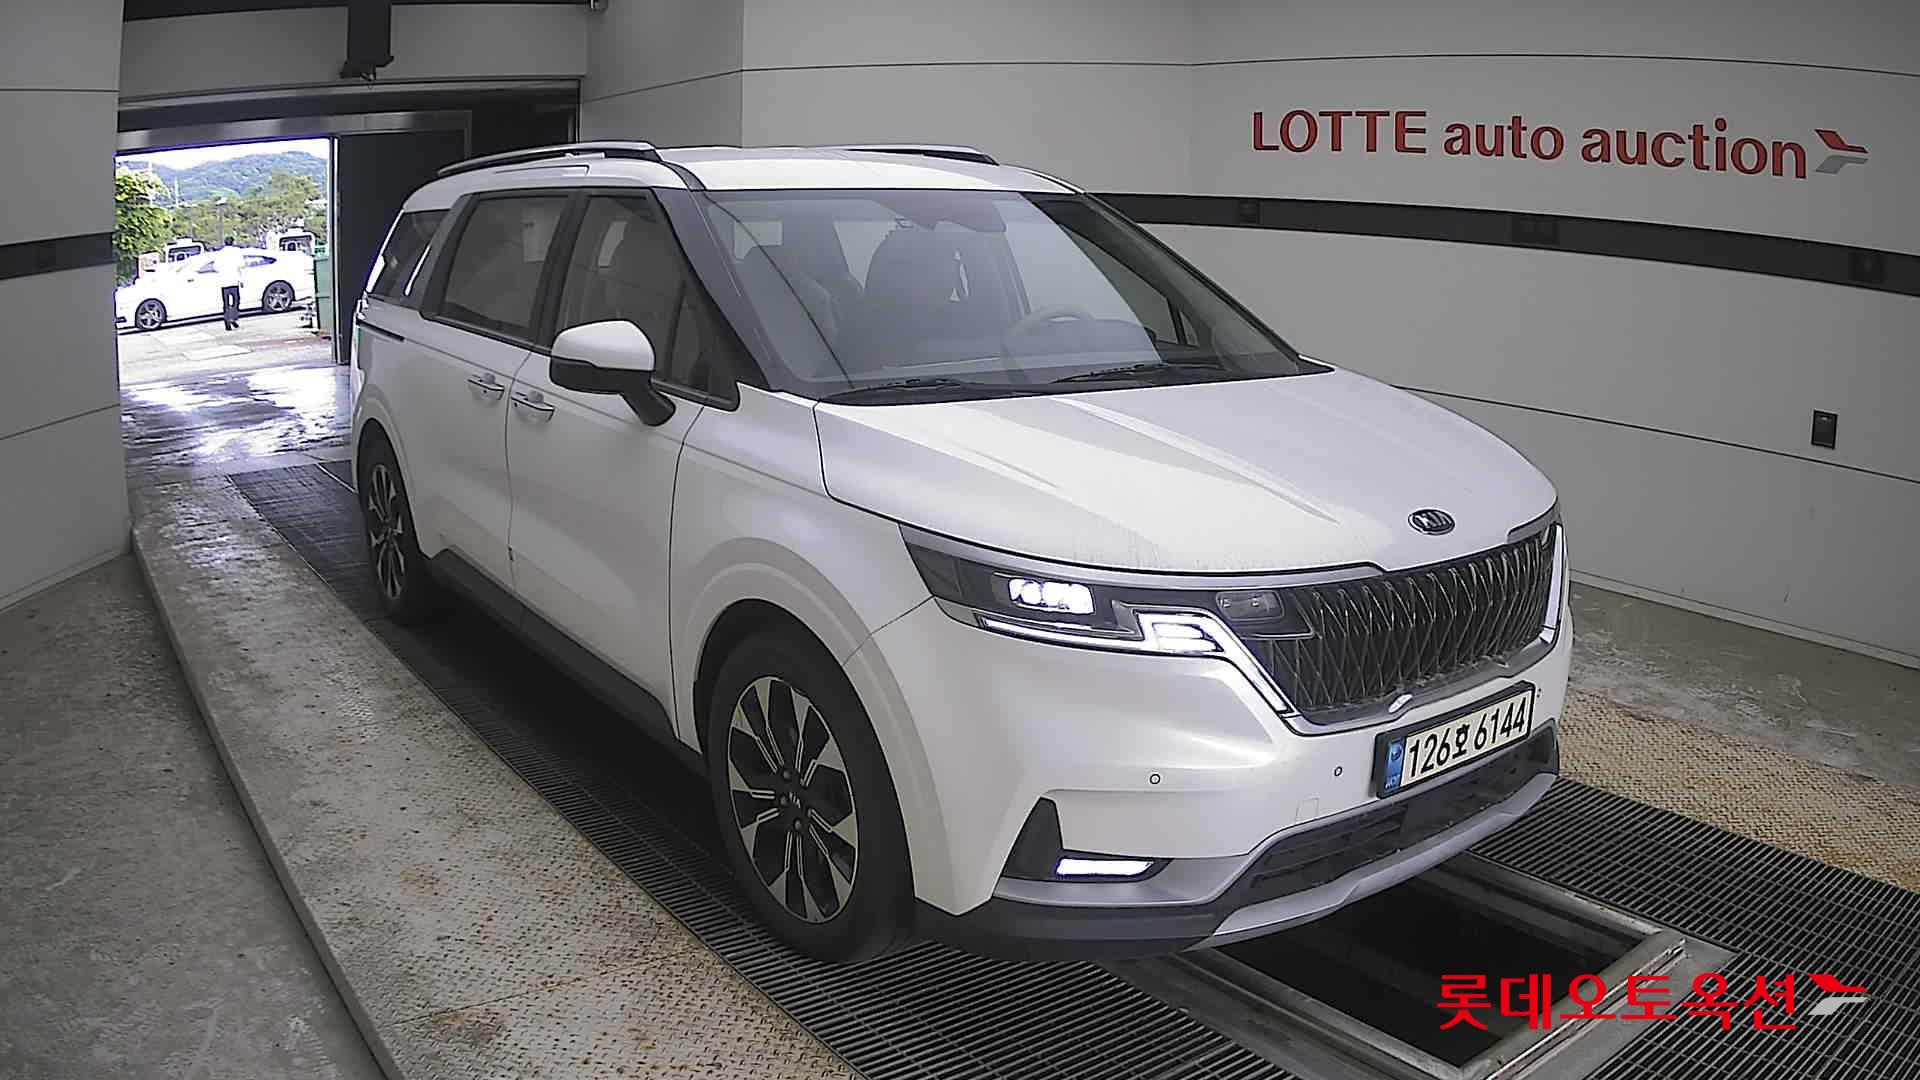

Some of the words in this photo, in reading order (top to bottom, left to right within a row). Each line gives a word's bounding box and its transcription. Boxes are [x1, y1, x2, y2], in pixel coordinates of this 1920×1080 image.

[1253, 110, 1427, 154] LOTTE
[1444, 116, 1565, 161] auto
[1581, 118, 1808, 180] auction
[1474, 697, 1527, 750] 6144
